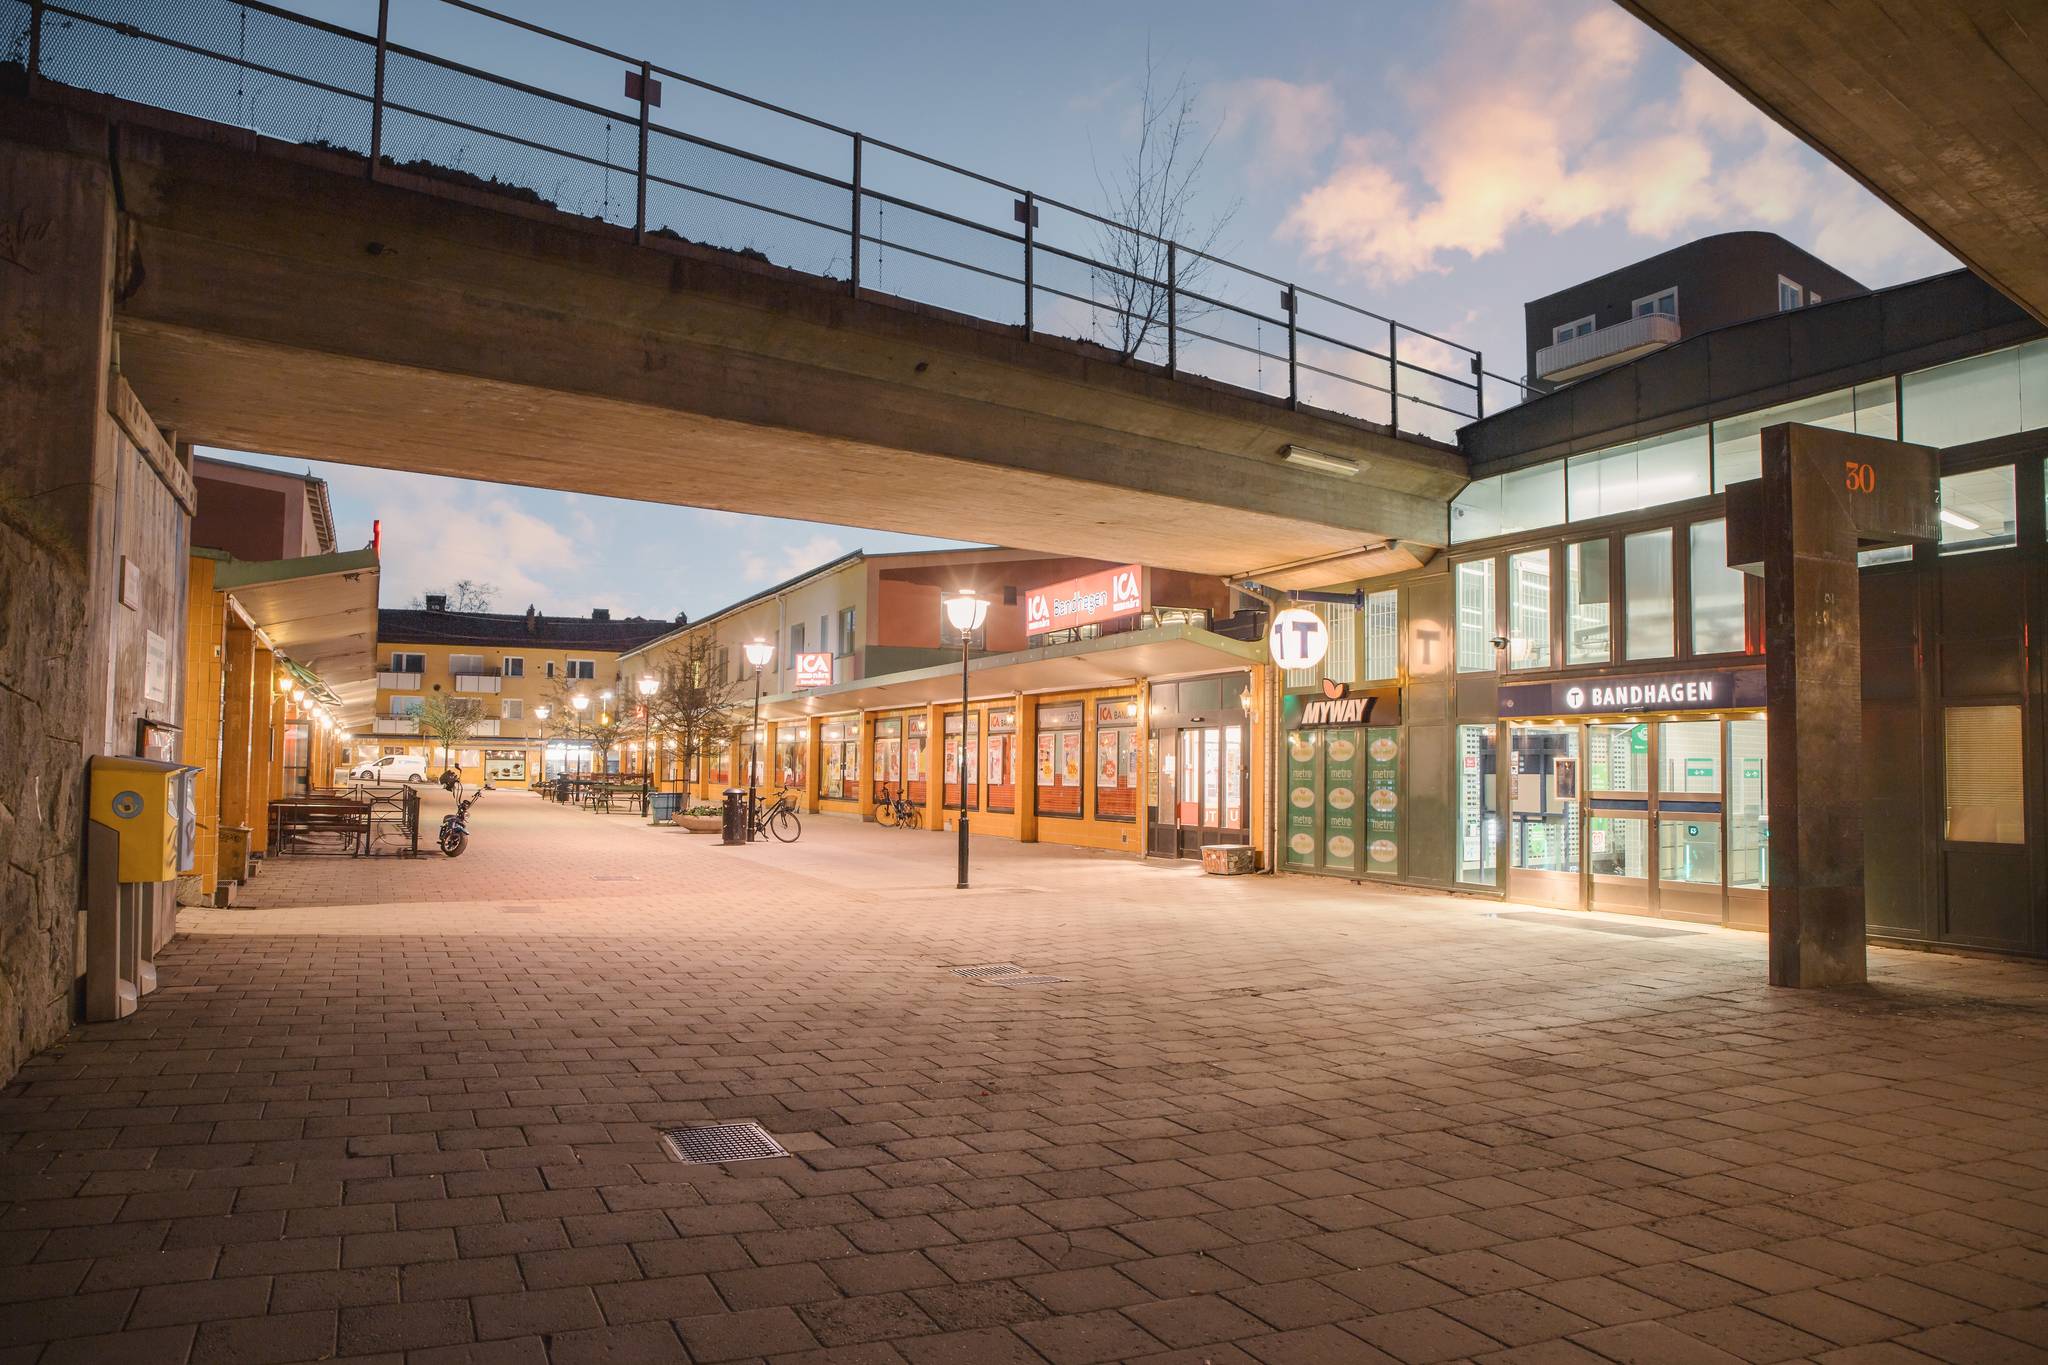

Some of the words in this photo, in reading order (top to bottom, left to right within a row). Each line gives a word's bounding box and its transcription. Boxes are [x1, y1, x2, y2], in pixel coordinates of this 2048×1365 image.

[1846, 462, 1875, 493] 30
[1113, 571, 1140, 602] ICA
[1028, 594, 1050, 622] ICA
[1054, 591, 1108, 616] Bandhagen
[1292, 621, 1319, 659] T
[797, 655, 829, 673] ICA
[1592, 681, 1713, 706] BANDHAGEN
[1099, 707, 1112, 721] ICA
[1301, 697, 1369, 725] MYWAY
[1293, 767, 1312, 779] metro
[1331, 768, 1352, 779] metro
[1372, 768, 1395, 780] metro
[1293, 815, 1312, 826] metro
[1331, 816, 1352, 827] metro
[1372, 819, 1395, 831] metro
